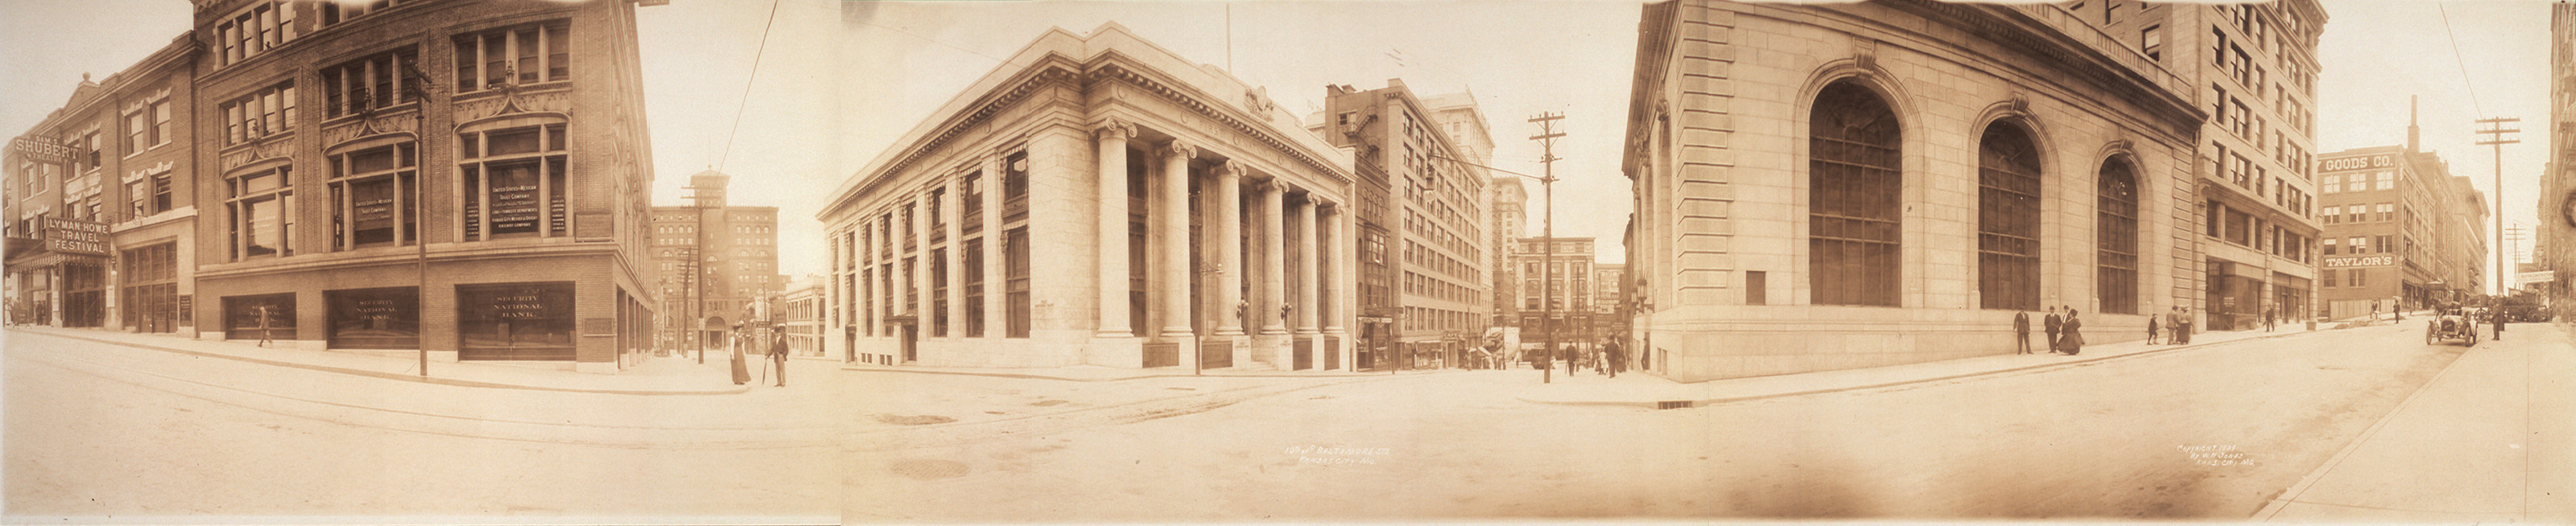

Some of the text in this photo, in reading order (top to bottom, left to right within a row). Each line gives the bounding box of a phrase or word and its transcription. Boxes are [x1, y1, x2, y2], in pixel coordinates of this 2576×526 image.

[16, 138, 78, 159] SHUBERT
[33, 153, 63, 162] THEATRE
[2326, 156, 2368, 171] GOODS
[2373, 155, 2393, 167] CO.
[49, 219, 108, 234] LYMAN HOWE
[60, 230, 99, 242] TRAVEL
[56, 240, 104, 253] FESTIVAL
[2326, 256, 2392, 267] TAYLOR'S
